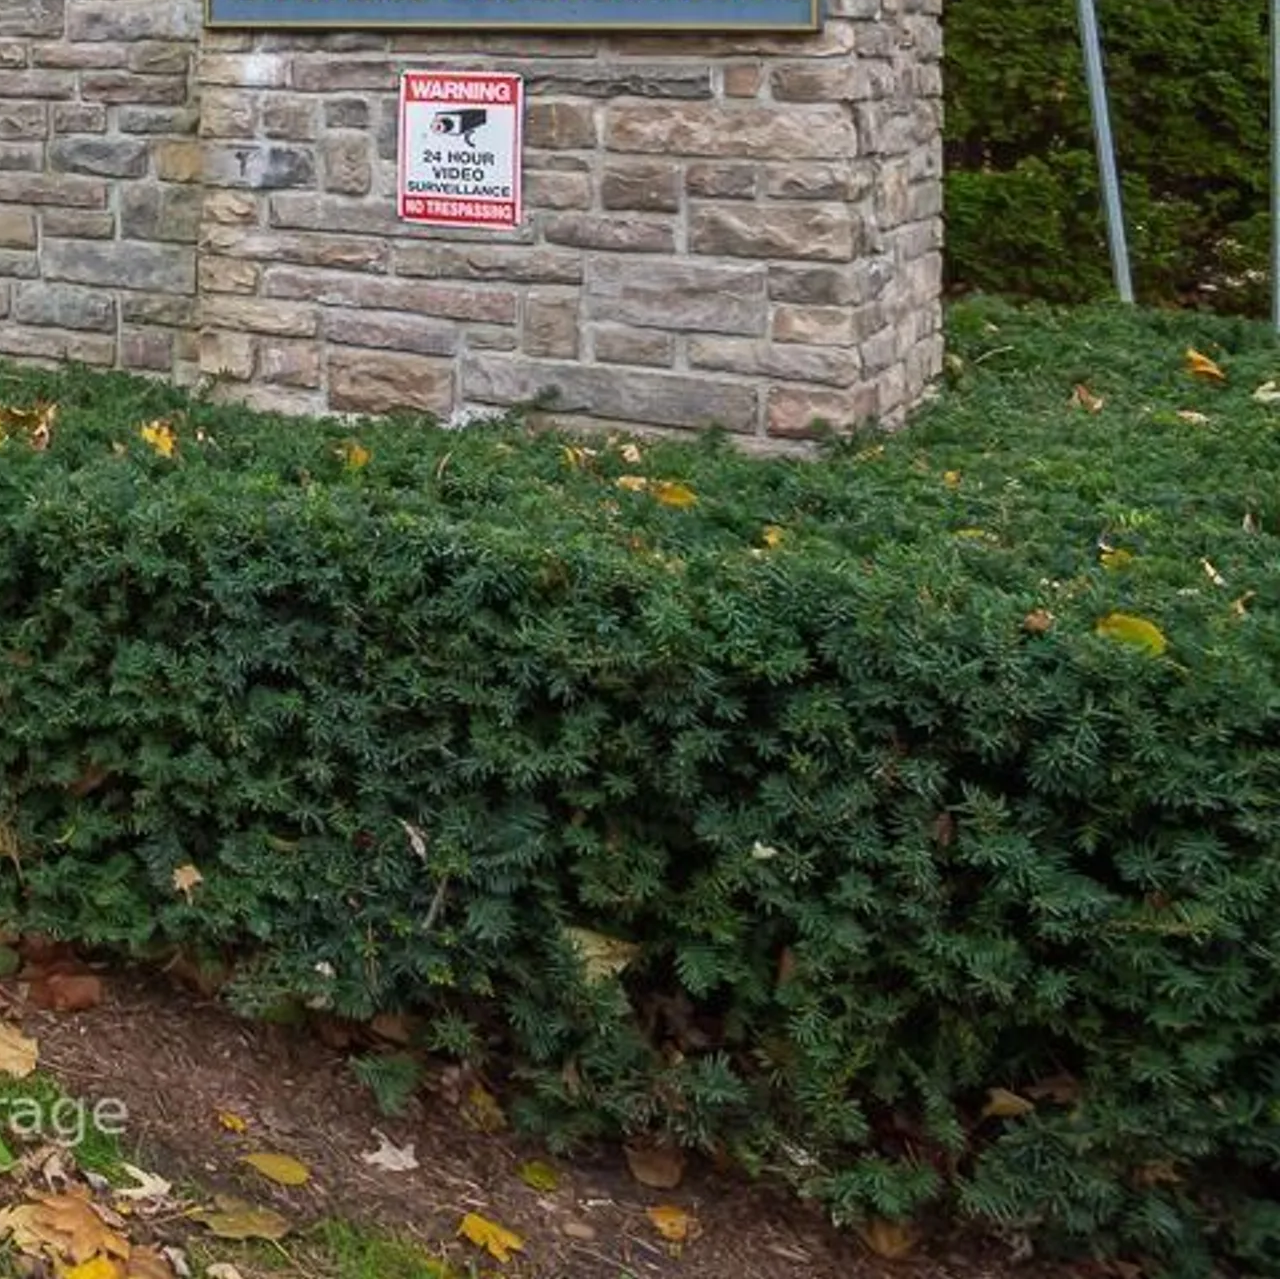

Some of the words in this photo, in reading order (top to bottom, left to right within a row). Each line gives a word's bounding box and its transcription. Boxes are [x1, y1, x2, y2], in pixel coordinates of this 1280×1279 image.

[410, 79, 513, 102] WARNING
[423, 149, 442, 165] 24
[447, 151, 495, 166] HOUR
[432, 167, 484, 181] VIDEO
[408, 181, 510, 198] SURVEILLANCE
[405, 198, 425, 214] NO
